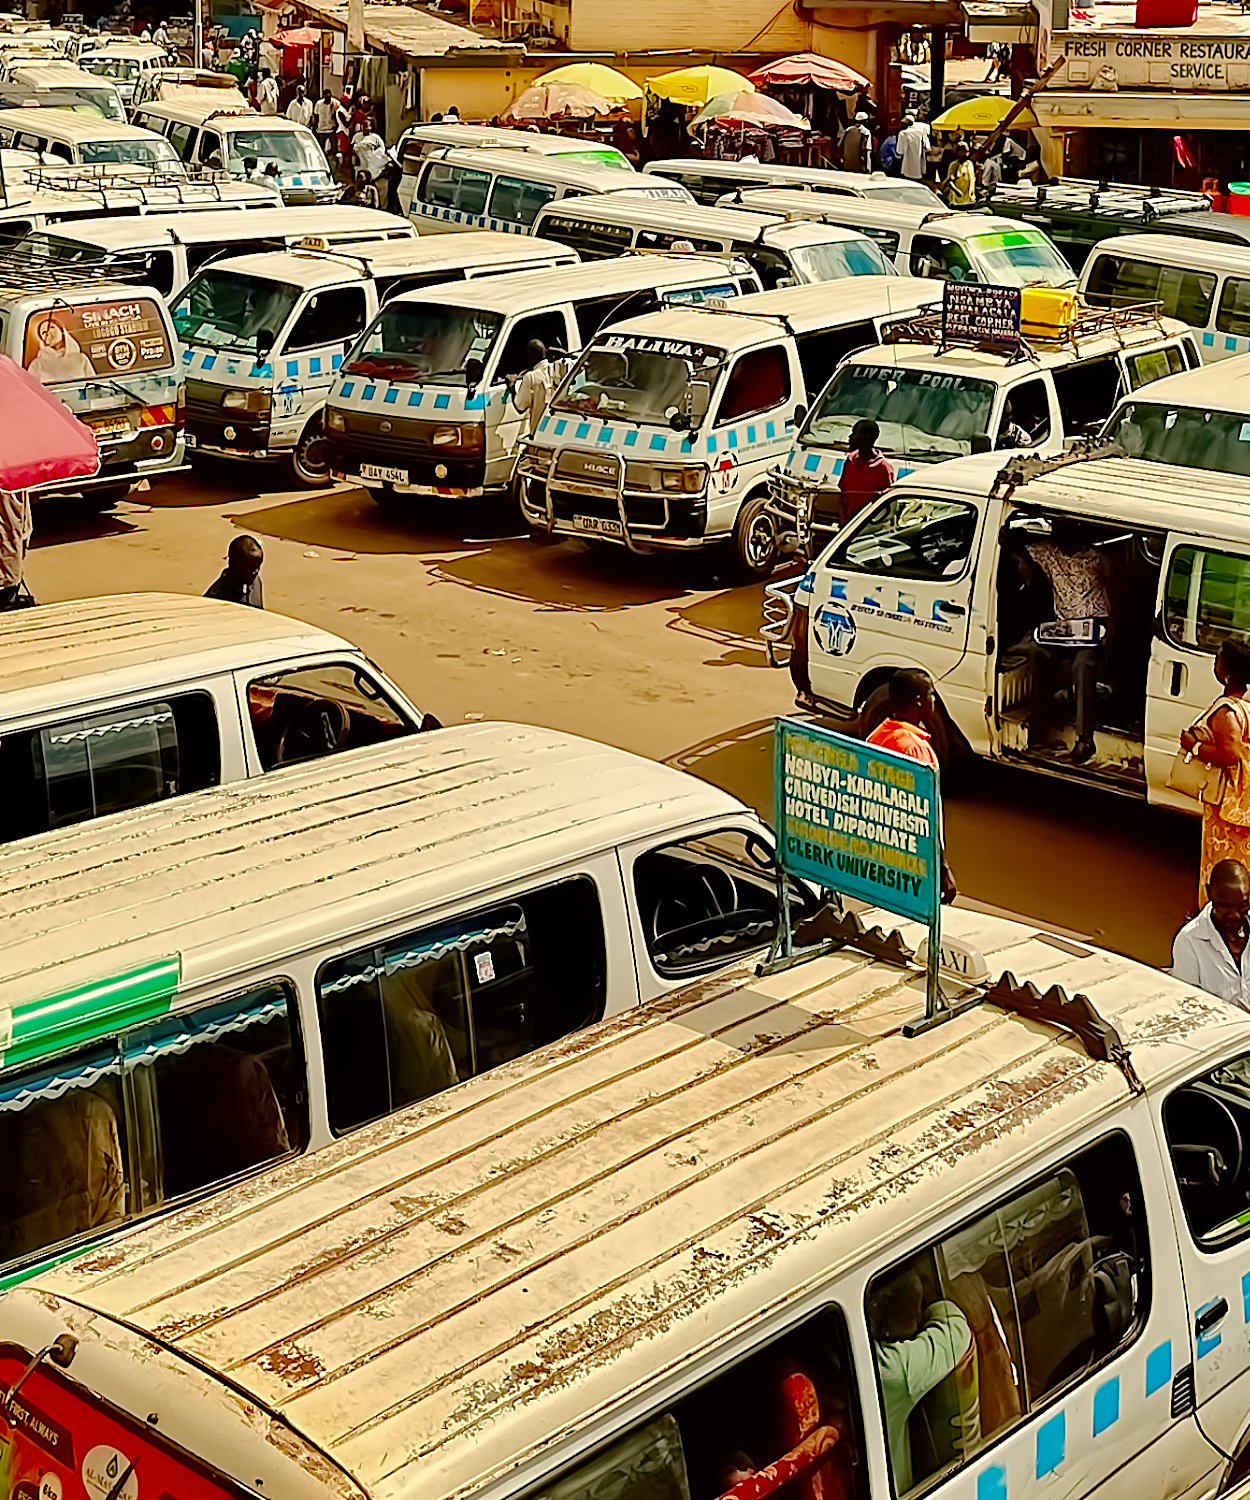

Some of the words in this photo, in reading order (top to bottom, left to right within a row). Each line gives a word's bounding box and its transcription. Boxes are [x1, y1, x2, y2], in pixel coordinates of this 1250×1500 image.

[1065, 41, 1107, 58] FRESH
[1116, 41, 1172, 58] CORNER
[1171, 63, 1225, 80] SERVICE
[949, 295, 1012, 310] NSAMBYA
[81, 303, 142, 324] SINACH
[946, 312, 971, 326] REST
[605, 336, 693, 357] BALIWA
[852, 366, 906, 381] LIVER
[918, 373, 967, 391] POOL
[784, 776, 860, 817] CARVEDISH
[785, 796, 830, 827] HOTEL
[833, 813, 918, 853] DIPROMATE
[786, 836, 834, 869] CLERK
[836, 851, 923, 898] UNIVERSITY
